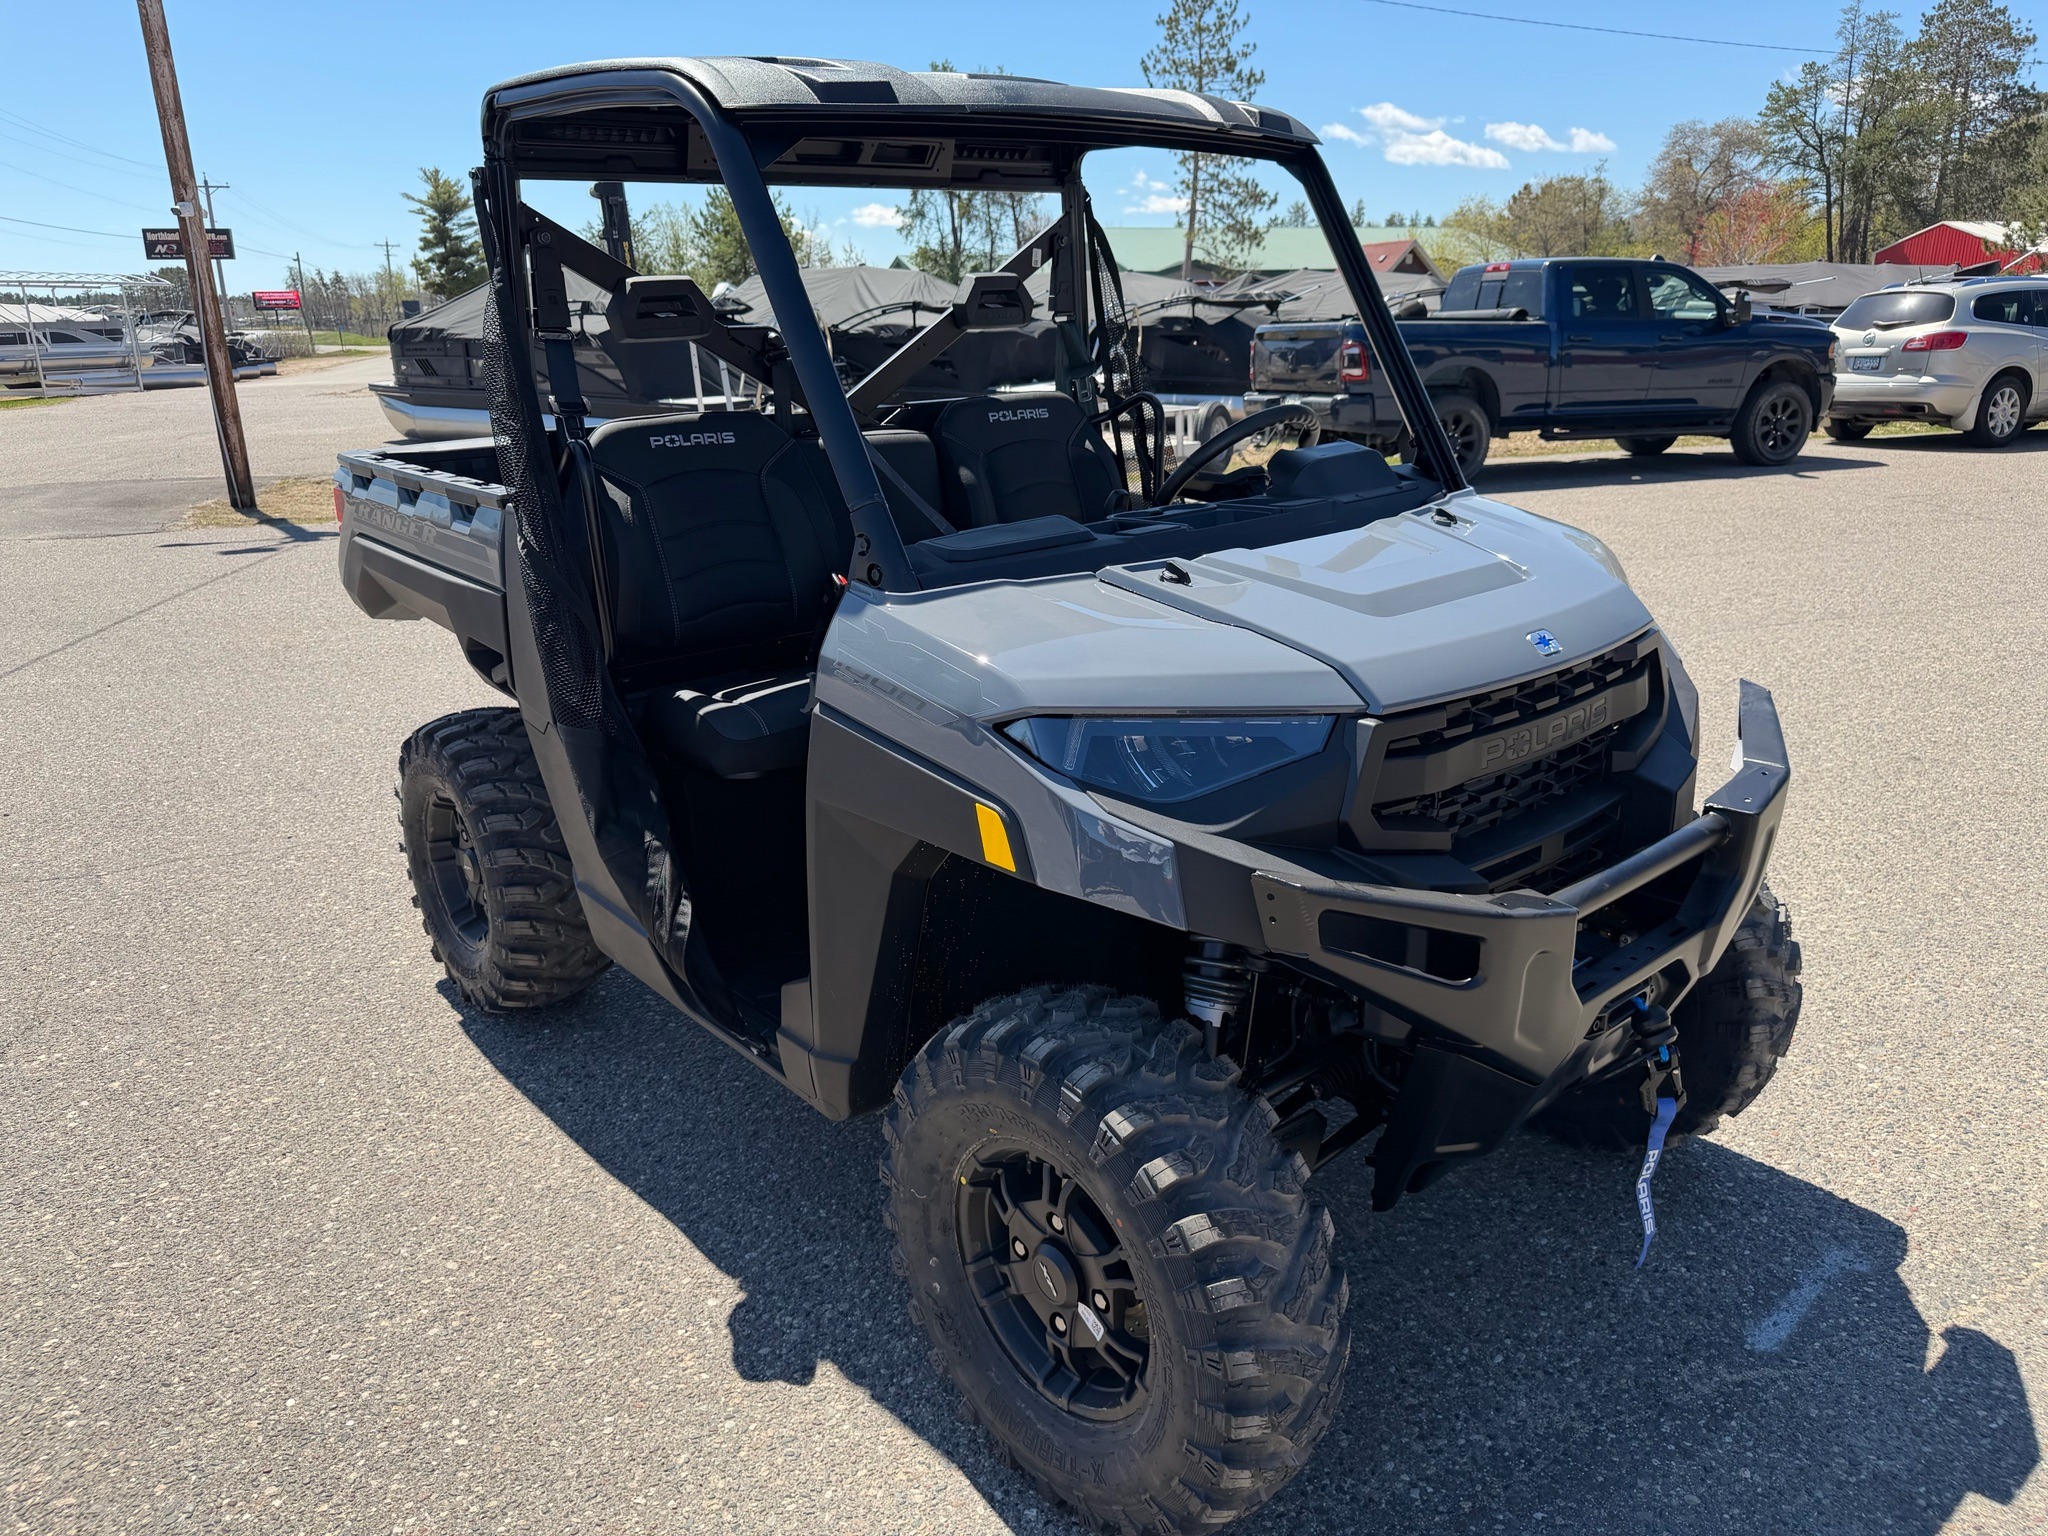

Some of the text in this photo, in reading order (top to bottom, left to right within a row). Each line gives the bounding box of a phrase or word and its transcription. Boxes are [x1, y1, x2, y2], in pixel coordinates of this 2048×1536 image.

[146, 232, 180, 241] Northland
[988, 408, 1049, 423] POLARIS
[649, 432, 736, 449] POLARIS
[357, 504, 438, 546] RANGER
[1480, 696, 1607, 771] POLARIS
[1637, 1149, 1660, 1236] POLARIS
